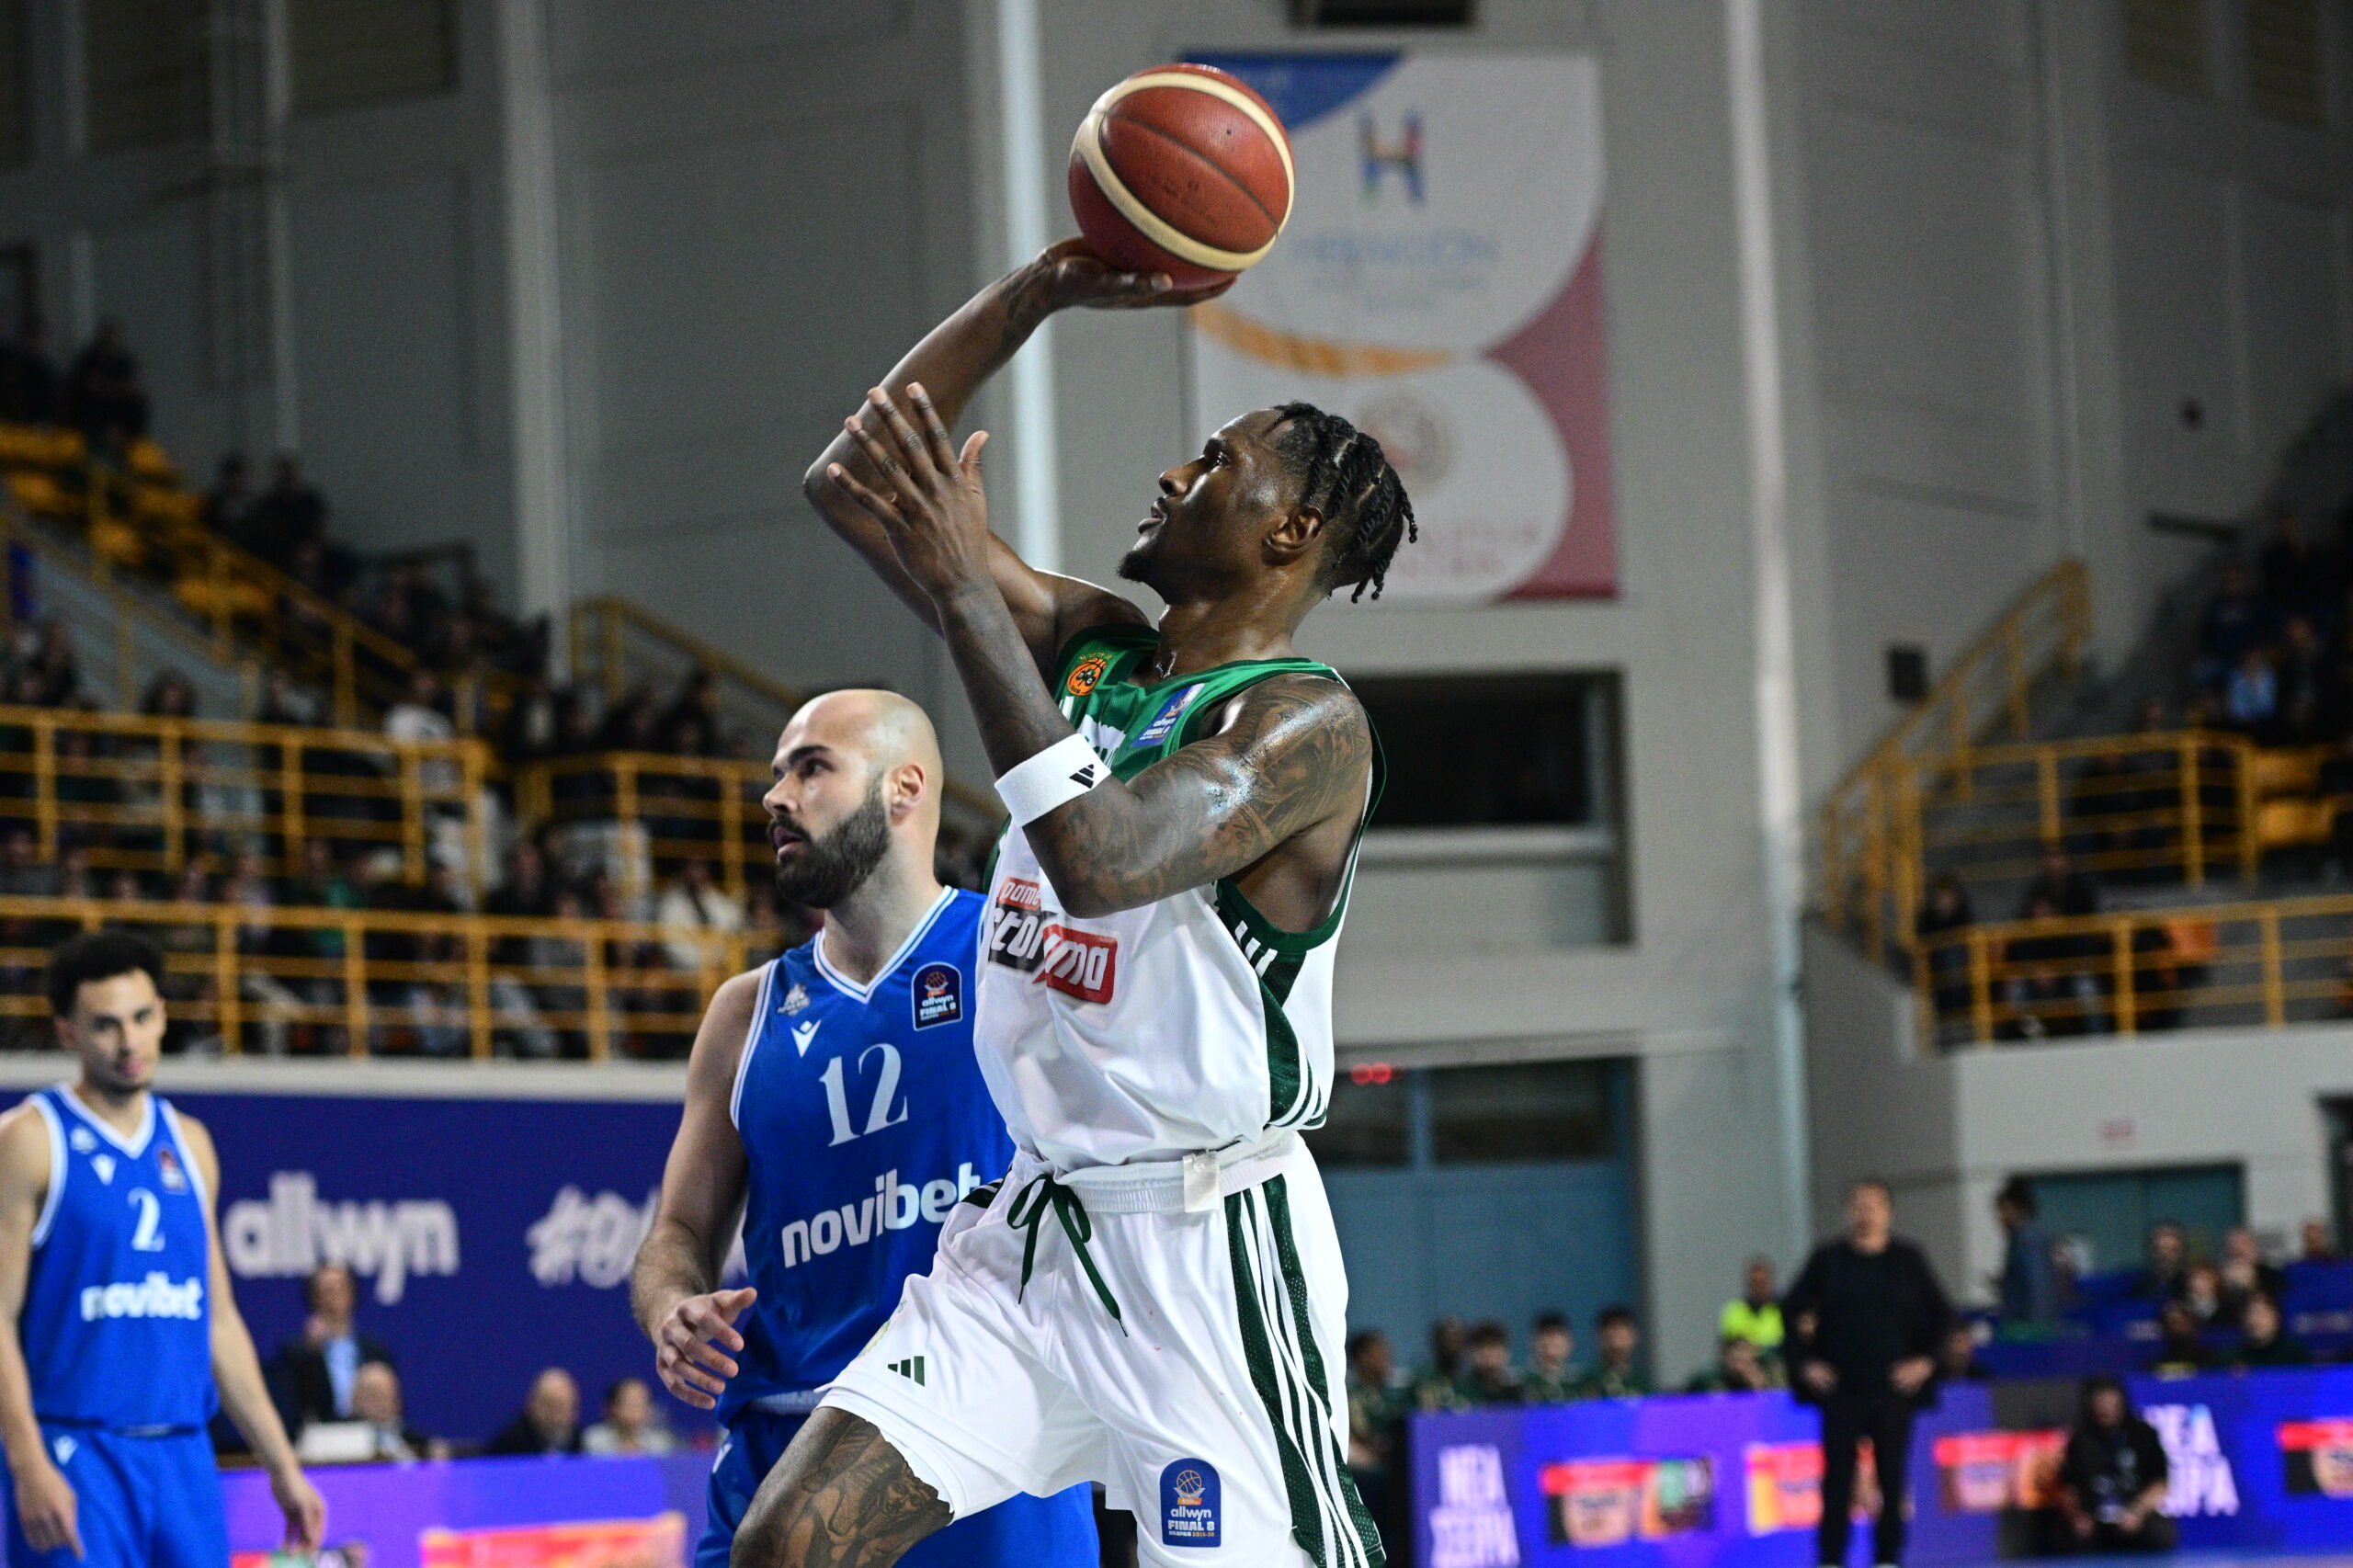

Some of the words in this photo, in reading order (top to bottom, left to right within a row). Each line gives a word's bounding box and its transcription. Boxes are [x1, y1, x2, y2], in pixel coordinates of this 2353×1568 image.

[819, 1043, 908, 1147] 12
[127, 1187, 165, 1252] 2
[223, 1171, 460, 1306] allwyn
[781, 1162, 981, 1268] novibet
[81, 1270, 202, 1322] novibet
[1168, 1519, 1204, 1531] FINAL
[1206, 1521, 1215, 1531] 8
[1170, 1506, 1212, 1521] allwyn
